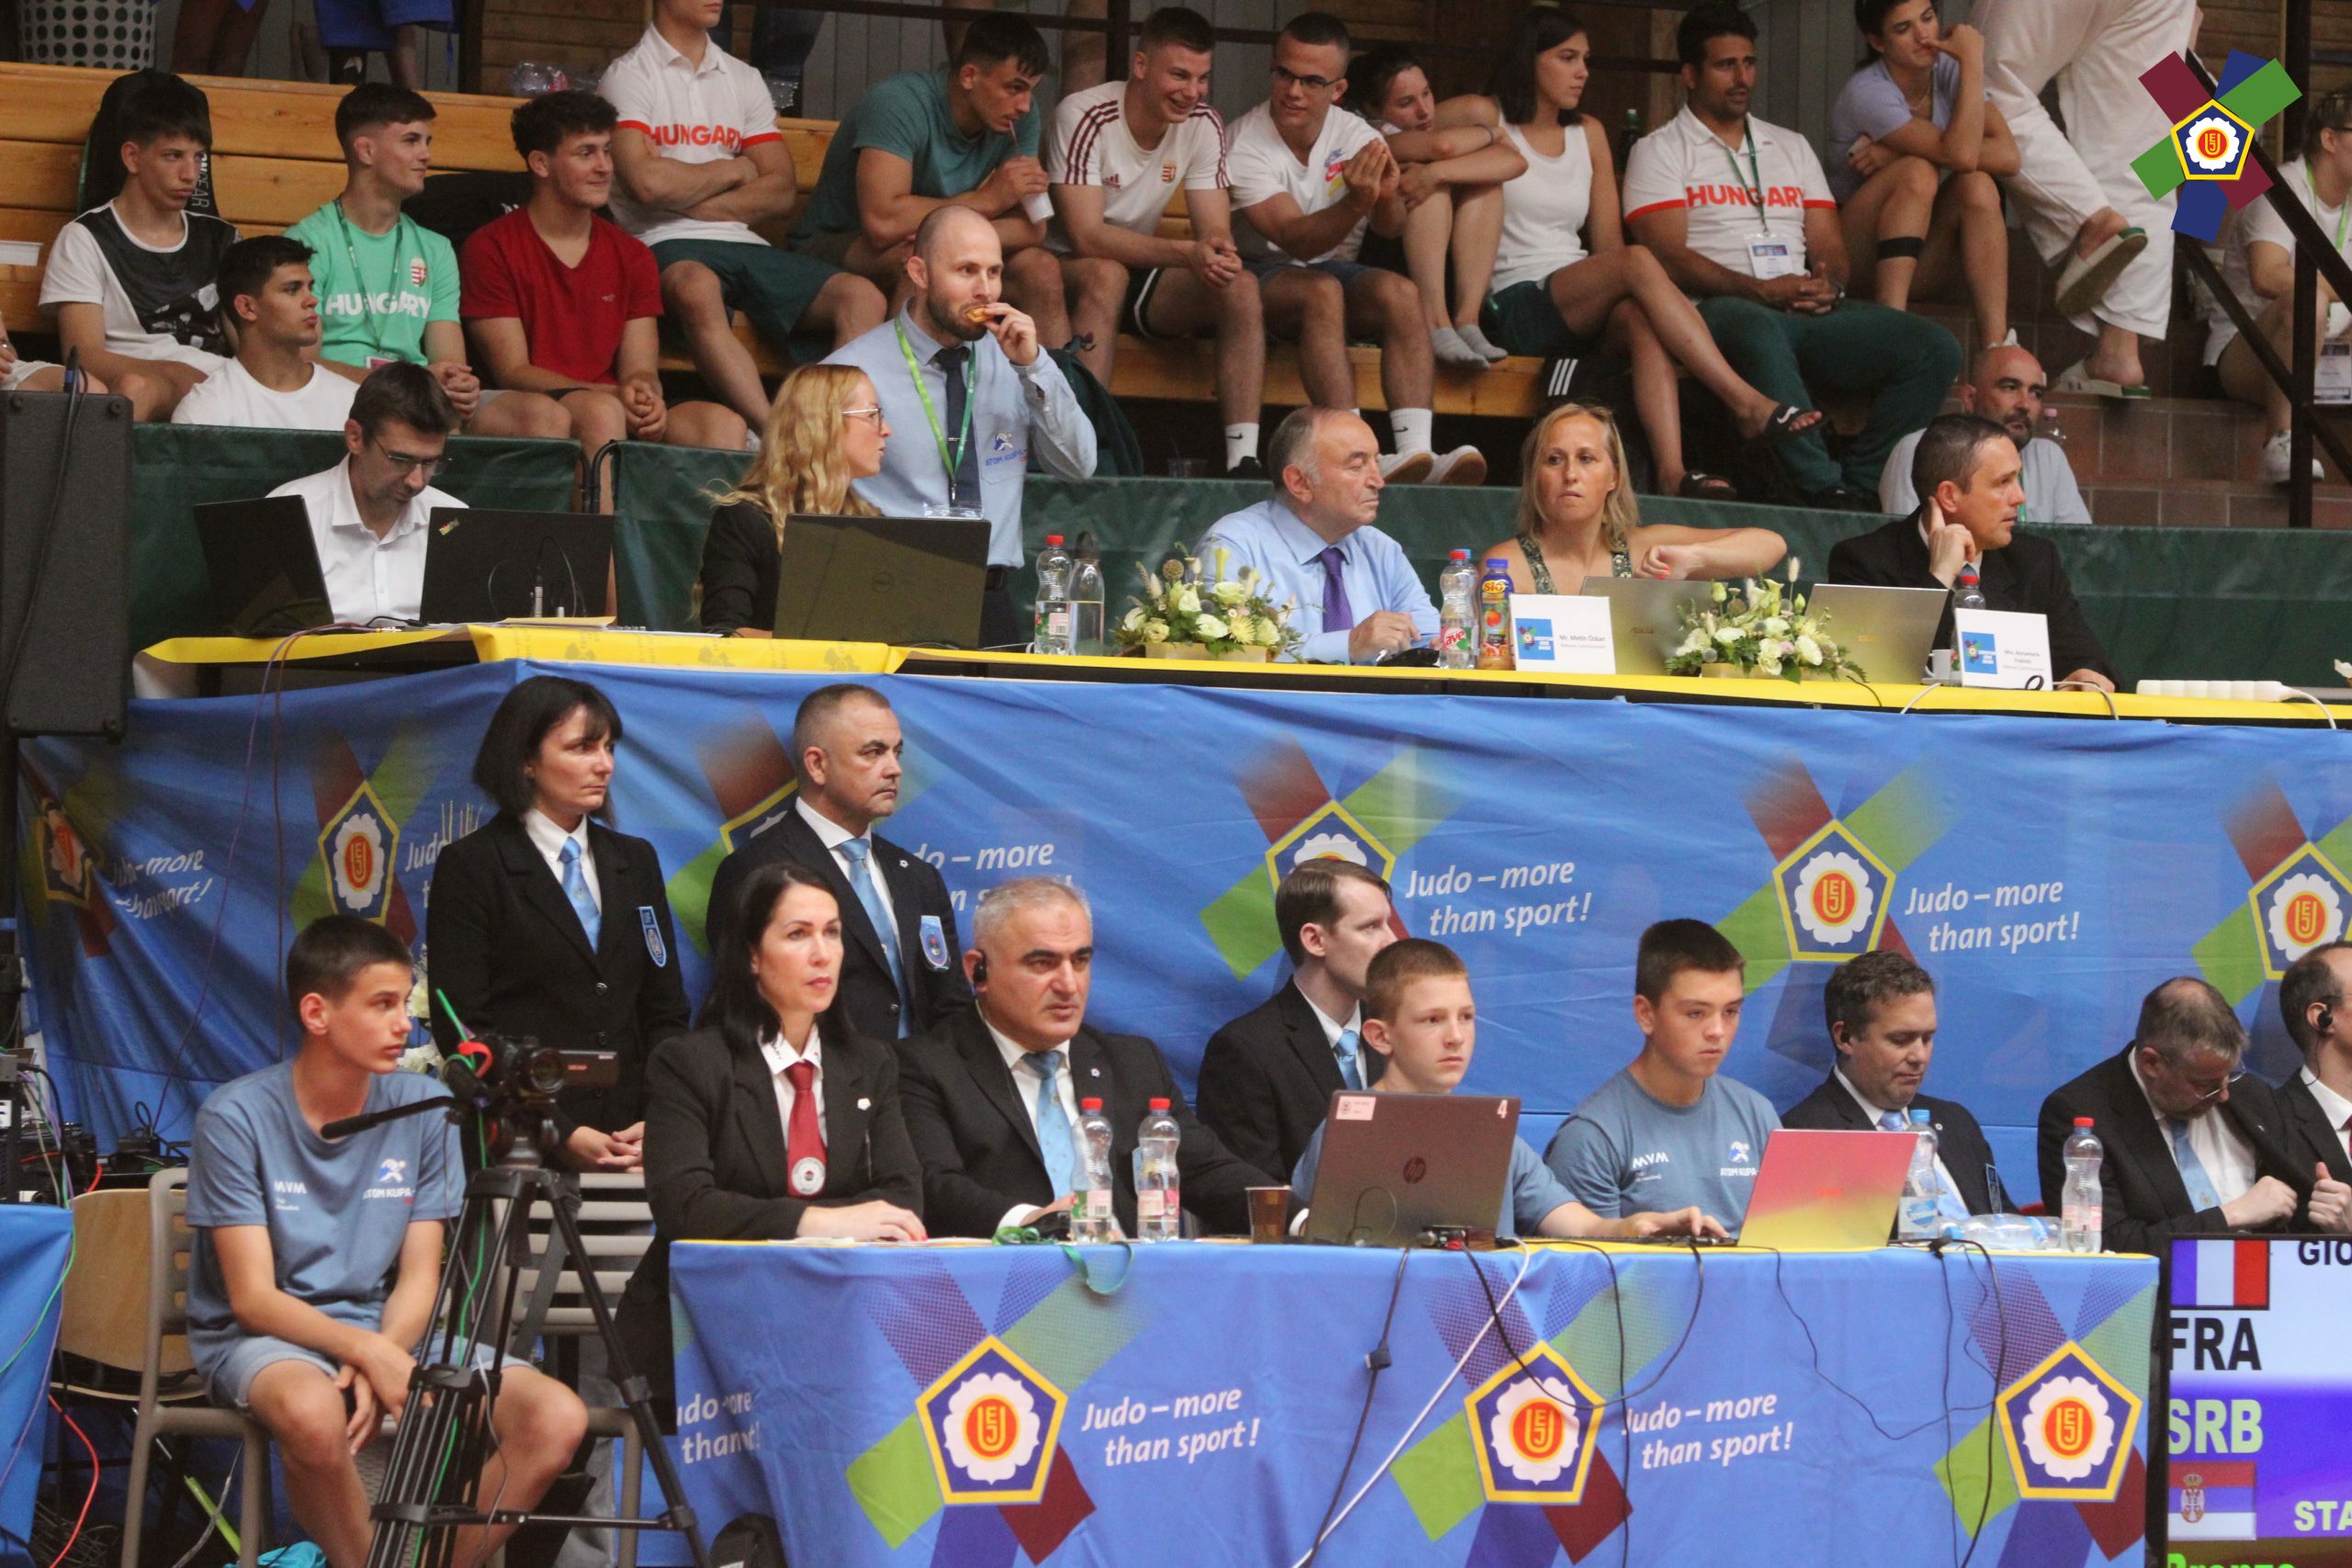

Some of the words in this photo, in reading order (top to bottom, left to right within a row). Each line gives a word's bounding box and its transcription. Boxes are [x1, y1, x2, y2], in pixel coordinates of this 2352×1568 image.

[325, 290, 432, 319] HUNGARY
[145, 849, 205, 876] more
[976, 843, 1055, 870] more
[1405, 864, 1472, 898] Judo
[1499, 862, 1576, 889] more
[1430, 905, 1495, 936] than
[1504, 892, 1592, 937] sport!
[1905, 883, 1969, 915] Judo
[1994, 881, 2064, 907] more
[1929, 921, 1991, 952] than
[2000, 911, 2080, 953] sport!
[1497, 1100, 1509, 1119] 4
[1632, 1152, 1669, 1168] MVM
[274, 1180, 308, 1194] MVM
[2171, 1317, 2262, 1371] FRA
[723, 1392, 752, 1415] ore
[1080, 1395, 1147, 1432] Judo
[1173, 1388, 1242, 1418] more
[1621, 1401, 1681, 1437] Judo
[1705, 1393, 1778, 1422] more
[1104, 1435, 1170, 1467] than
[1177, 1417, 1261, 1464] sport!
[2168, 1398, 2264, 1455] SRB
[682, 1431, 741, 1464] than
[1642, 1438, 1702, 1470] than
[1710, 1421, 1794, 1467] sport!
